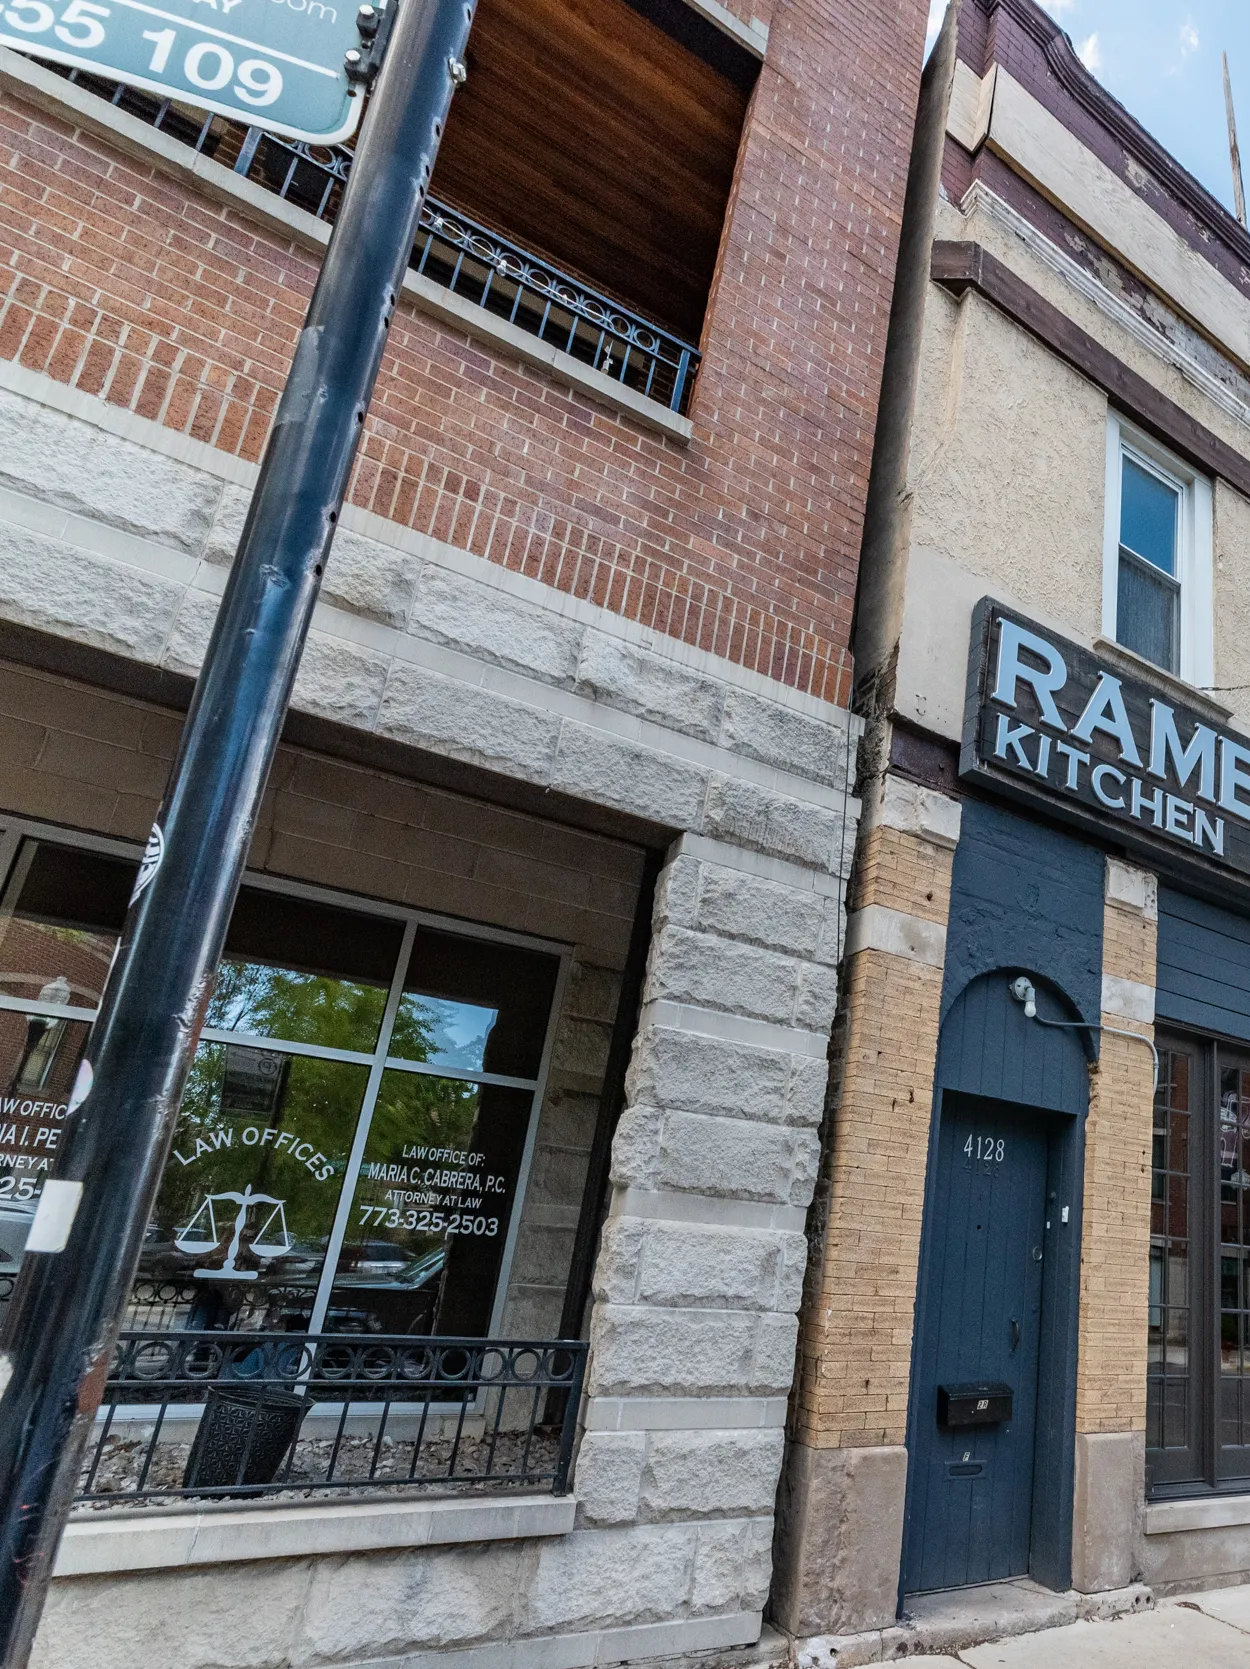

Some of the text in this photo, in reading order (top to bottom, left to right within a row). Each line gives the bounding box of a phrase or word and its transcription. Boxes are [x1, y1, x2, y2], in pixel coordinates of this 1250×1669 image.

[142, 28, 283, 107] 109
[995, 713, 1225, 856] KITCHEN
[37, 1157, 54, 1171] A
[173, 1127, 335, 1182] LAW OFFICES
[402, 1145, 486, 1167] LAW OFFICE OF:
[964, 1134, 1005, 1162] 4128
[367, 1162, 506, 1194] MARIA C. CABRERA, P.C.
[384, 1190, 483, 1209] ATTORNEY AT LAW
[359, 1205, 499, 1237] 773-325-2503
